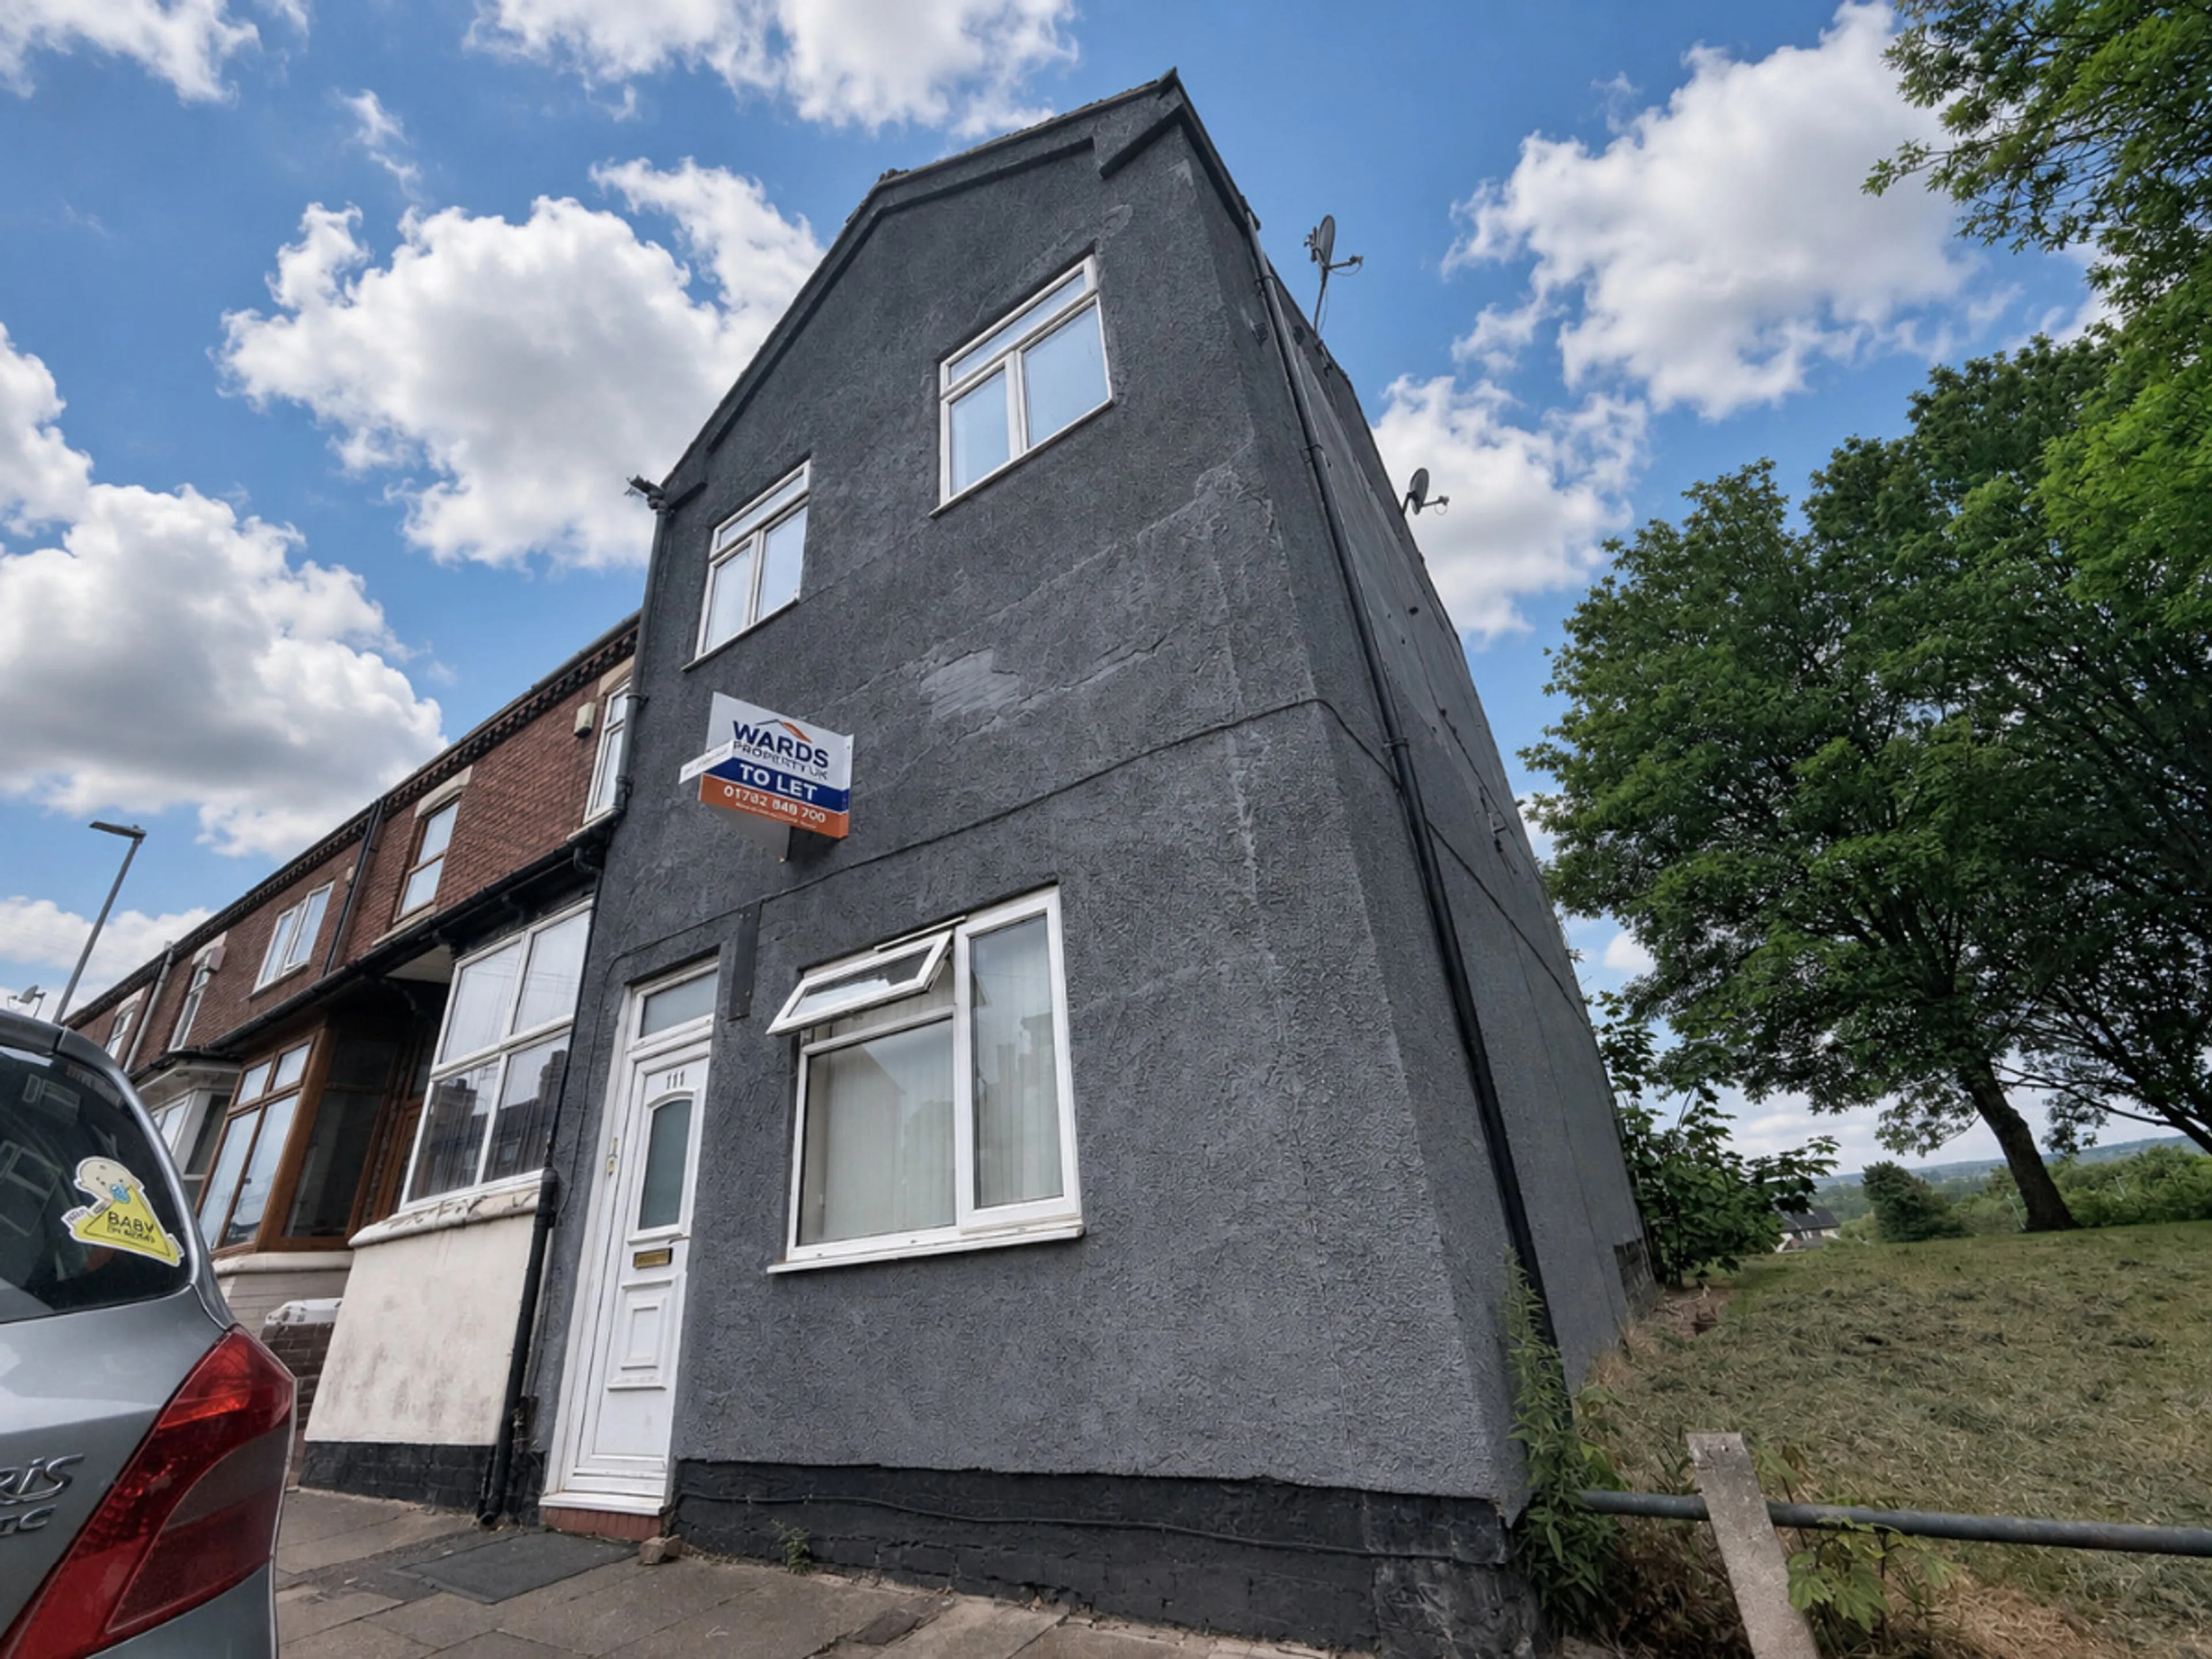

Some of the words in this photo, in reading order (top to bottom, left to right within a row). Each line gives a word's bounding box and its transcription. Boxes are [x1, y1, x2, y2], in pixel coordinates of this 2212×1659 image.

[733, 721, 829, 768] WARDS
[739, 763, 770, 786] TO
[777, 775, 817, 801] LET
[802, 806, 826, 823] 700
[108, 1211, 154, 1233] BABY
